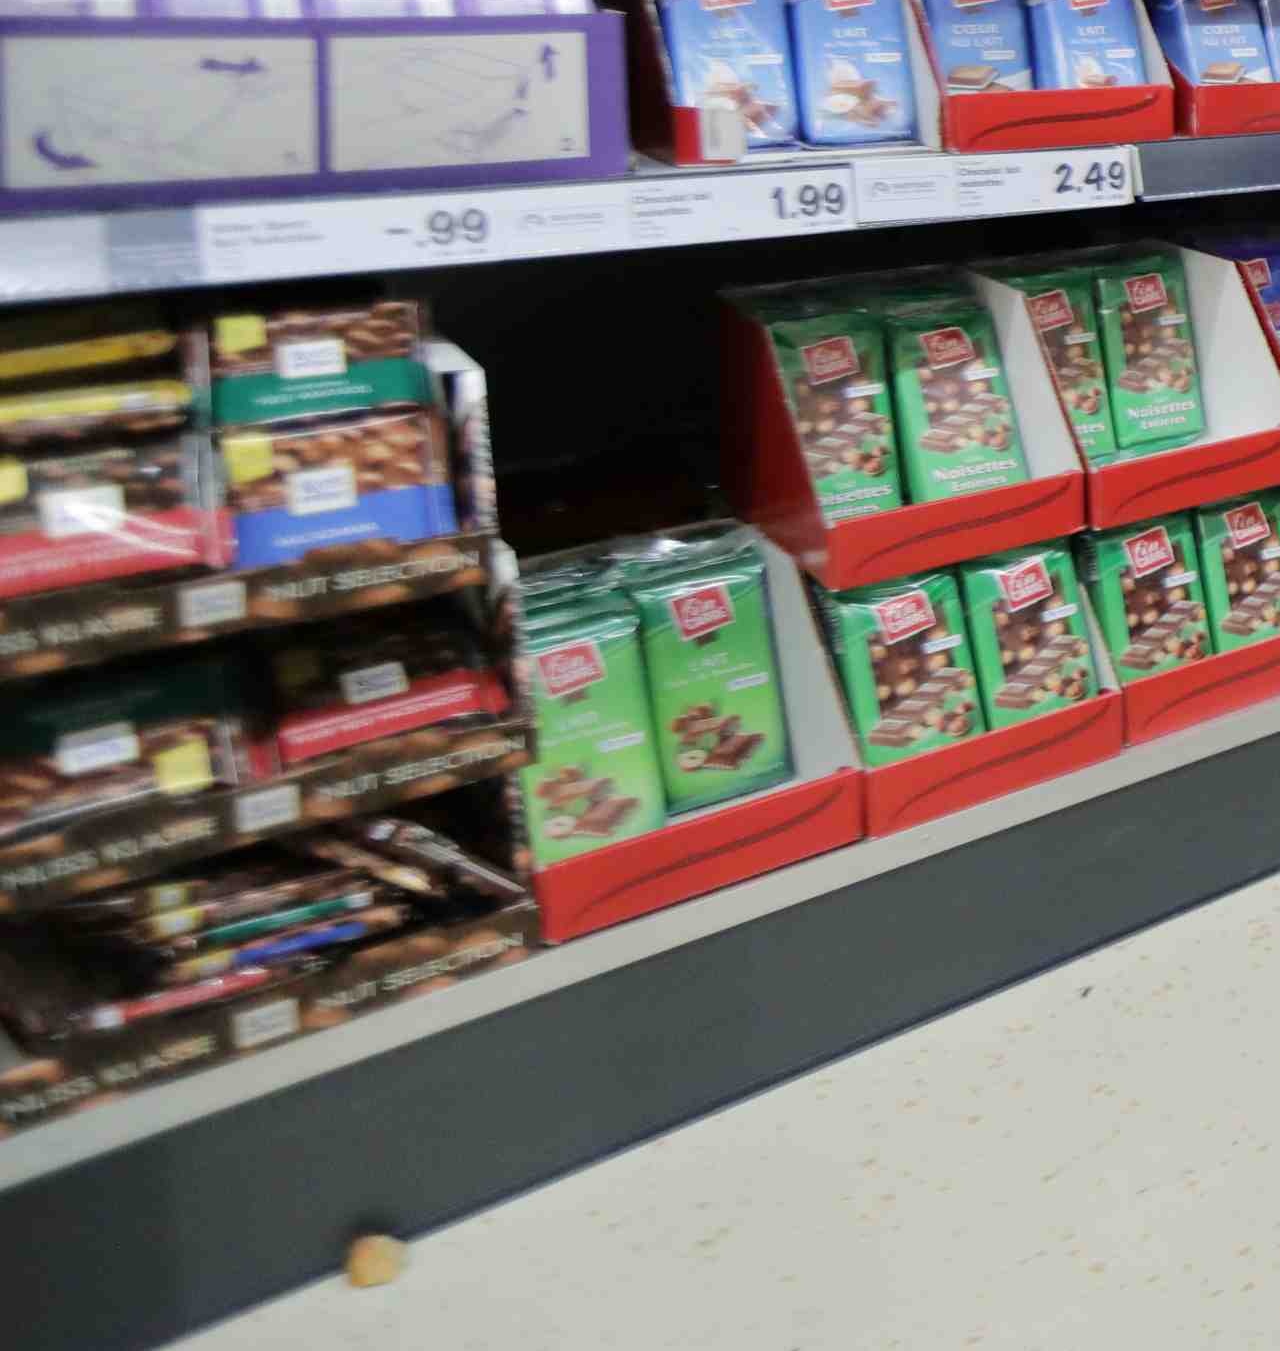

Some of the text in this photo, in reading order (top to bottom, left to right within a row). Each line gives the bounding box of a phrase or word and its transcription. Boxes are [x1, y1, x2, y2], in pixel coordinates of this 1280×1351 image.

[1054, 161, 1126, 196] 2.49
[771, 182, 845, 222] 1.99
[385, 208, 487, 248] -.99
[1128, 399, 1195, 420] Noisettes
